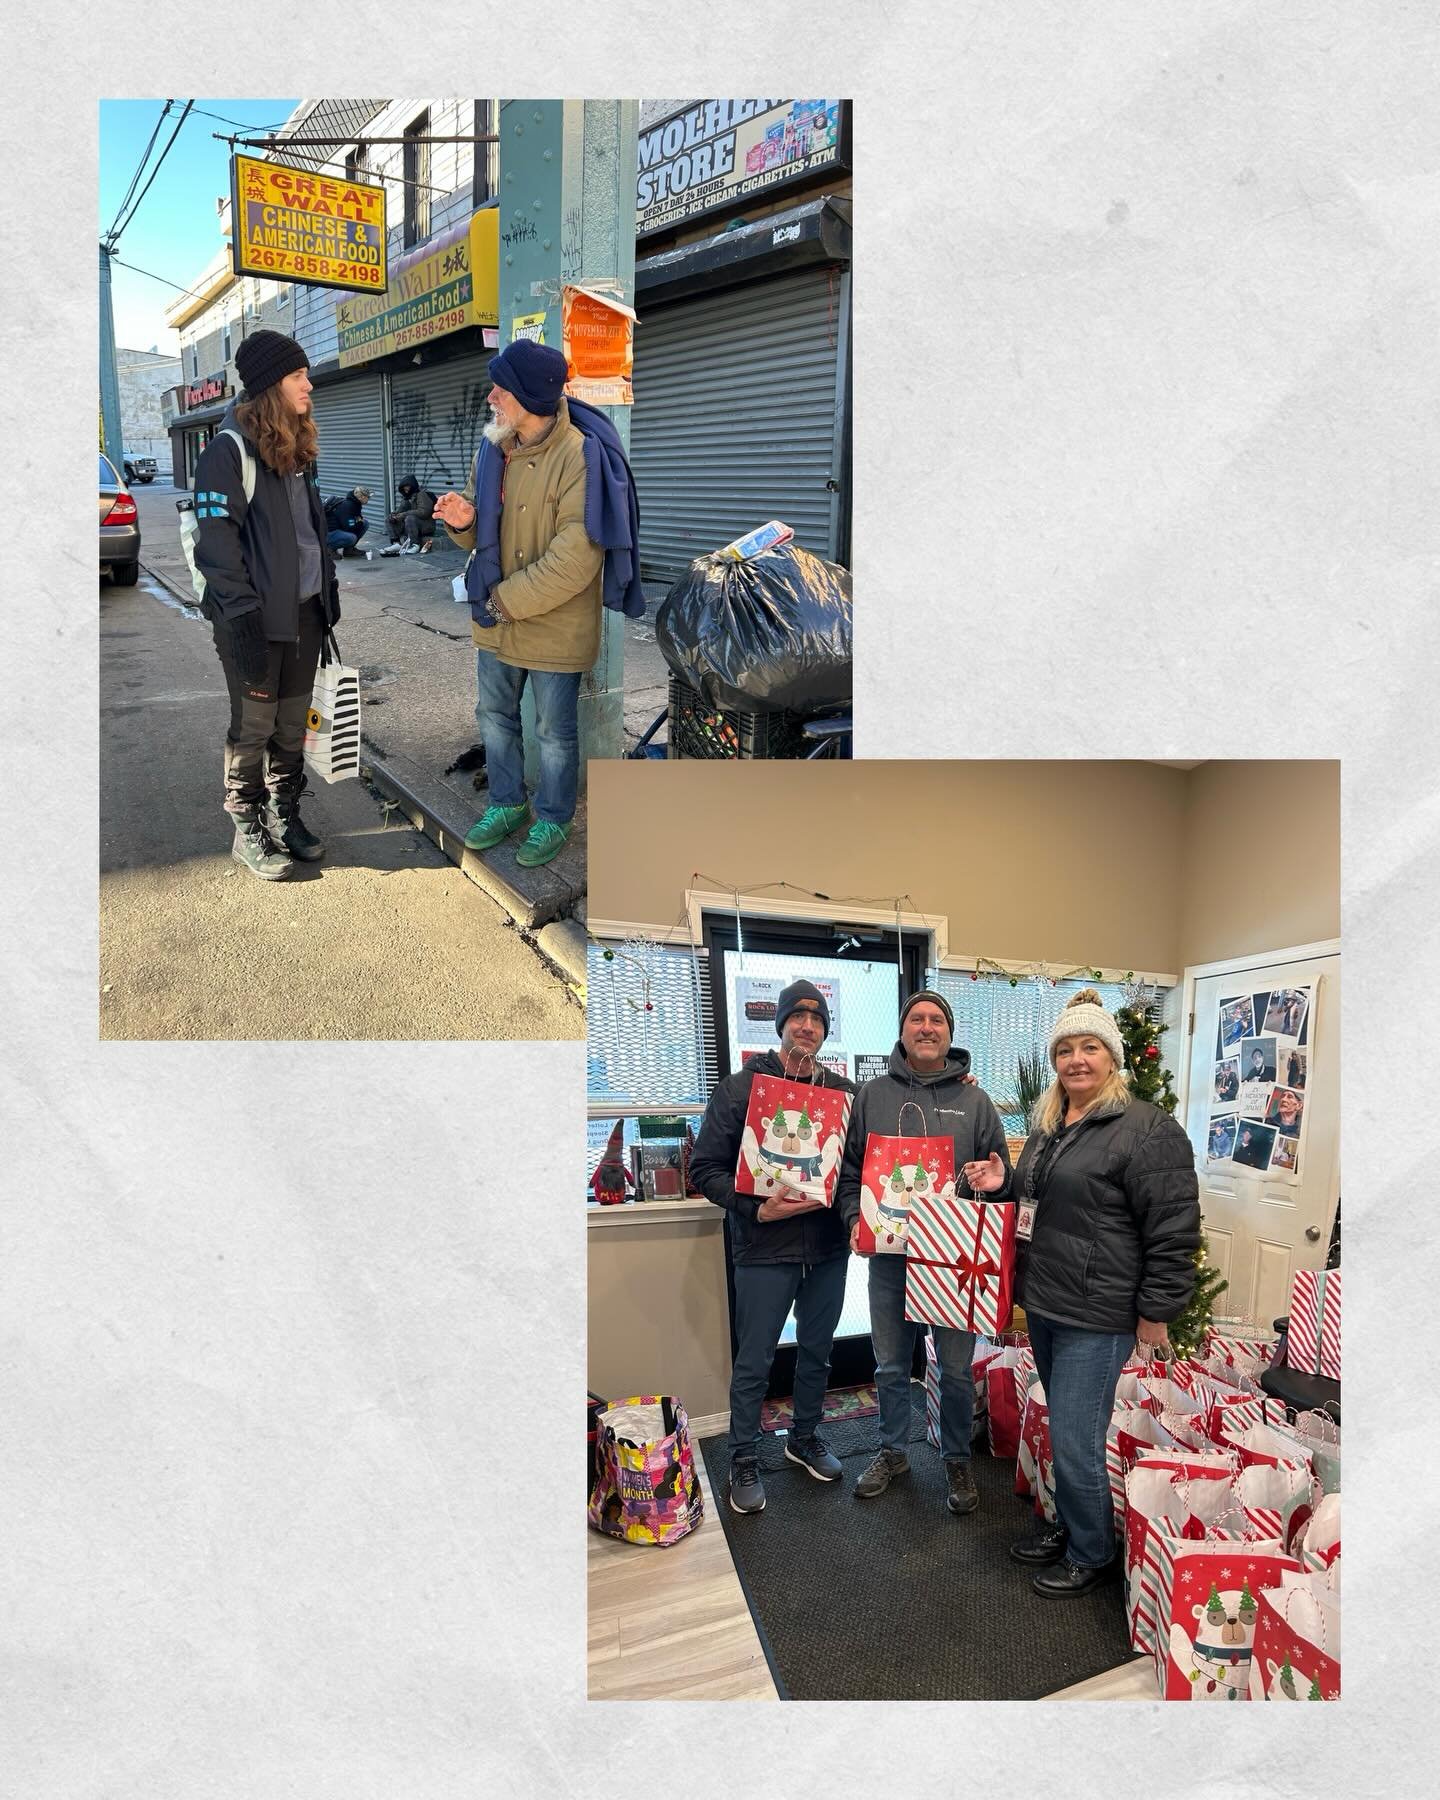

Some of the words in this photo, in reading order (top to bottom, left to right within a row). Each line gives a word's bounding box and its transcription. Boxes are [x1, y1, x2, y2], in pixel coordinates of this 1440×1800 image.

[637, 100, 783, 170] MOLHE
[637, 133, 736, 209] STORE
[643, 205, 687, 232] GROCERIES
[688, 198, 704, 215] ICE
[704, 185, 738, 208] CREAM
[741, 158, 806, 193] CIGARETTES
[809, 146, 837, 169] ATM
[270, 173, 379, 208] GREAT
[281, 191, 372, 223] WALL
[643, 202, 664, 219] OPEN
[664, 201, 669, 211] 7
[669, 194, 685, 208] DAY
[685, 192, 695, 202] 24
[696, 178, 725, 197] HOURS
[252, 224, 336, 257] AMERICAN
[339, 241, 378, 264] FOOD
[262, 206, 348, 240] CHINESE
[354, 224, 368, 244] &
[250, 248, 380, 283] 267-858-2198
[353, 293, 391, 323] Great
[398, 259, 441, 299] Wall
[344, 325, 375, 349] Chinese
[375, 320, 382, 336] &
[383, 300, 430, 333] American
[431, 282, 460, 311] Food
[395, 308, 465, 347] 267-858-2198
[574, 324, 608, 337] NOVEMBER
[345, 346, 366, 364] TAKE
[816, 1055, 839, 1063] lutely
[622, 1486, 655, 1501] MONTH
